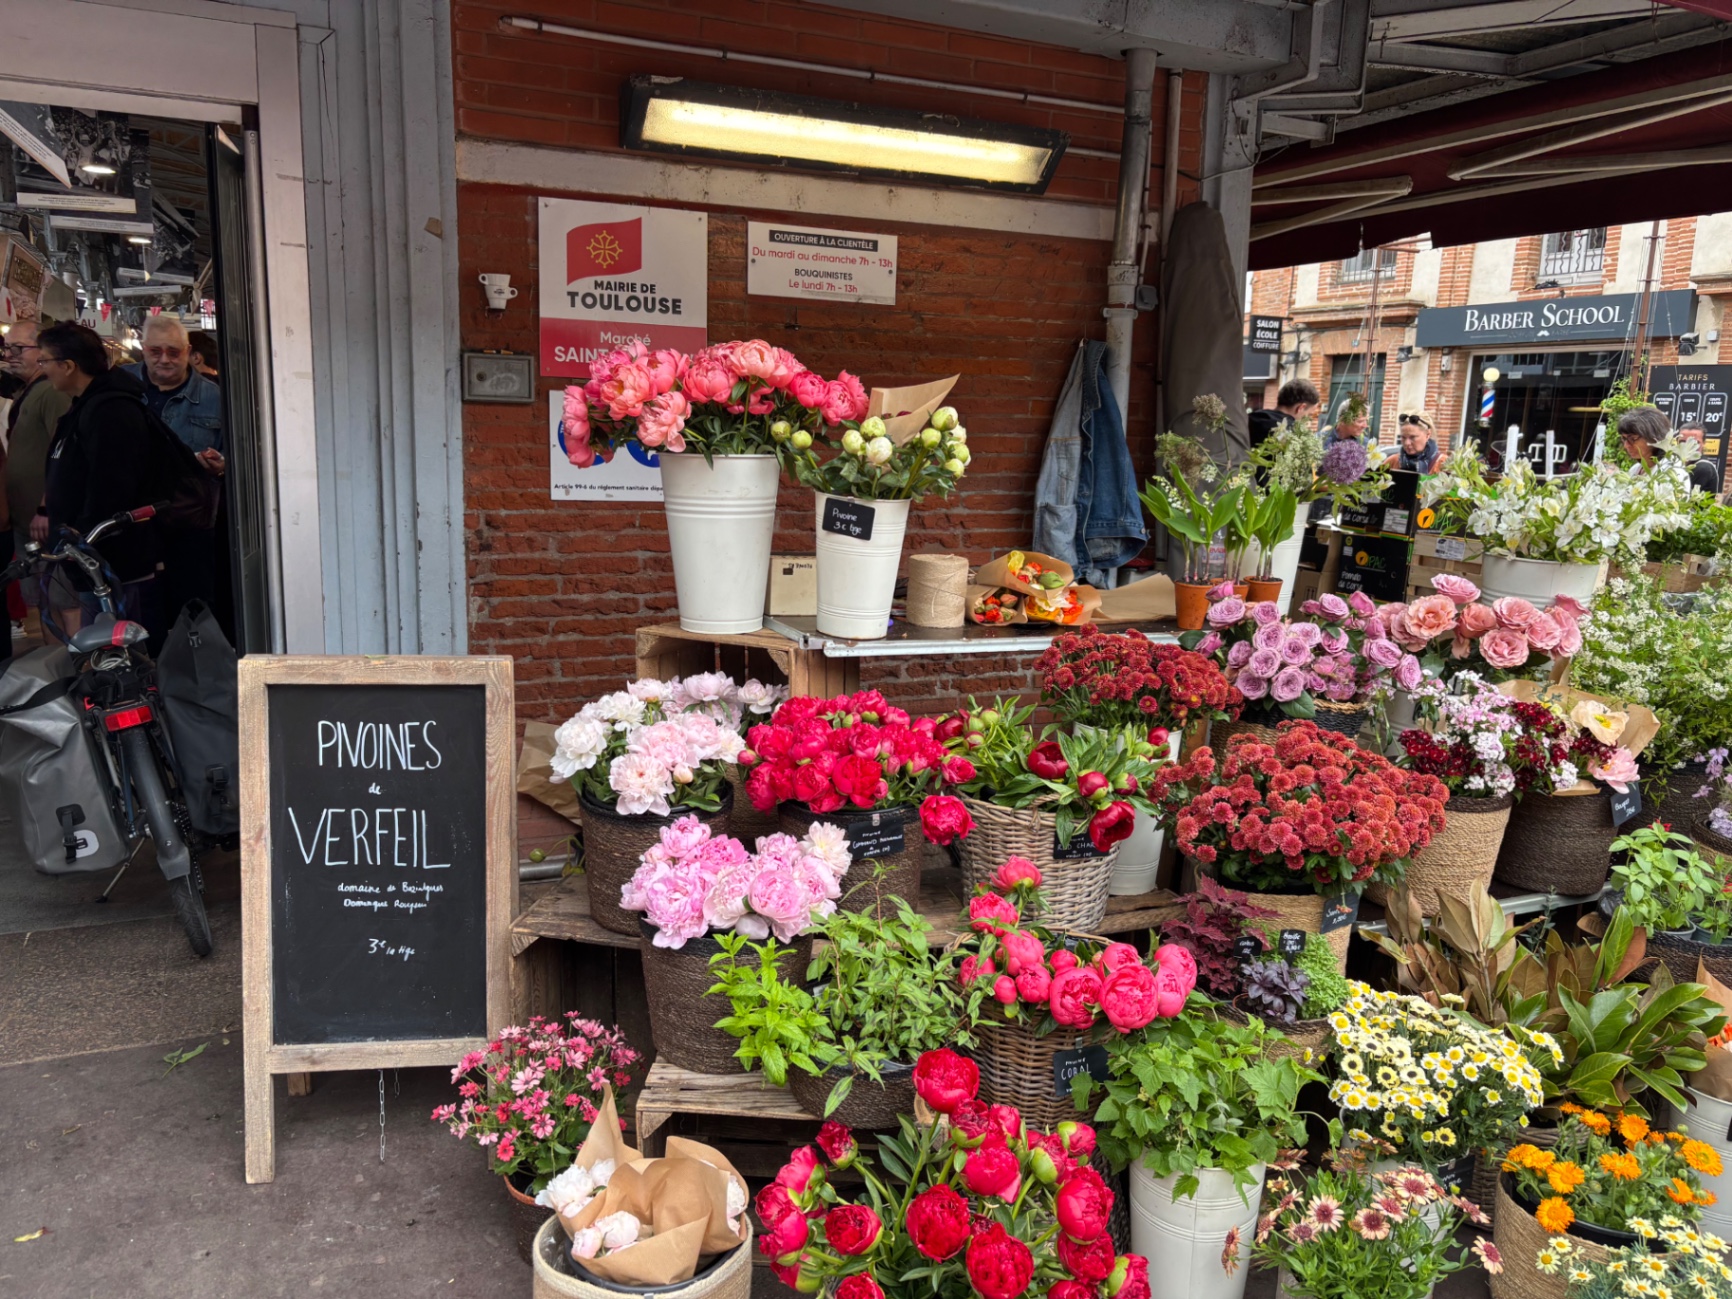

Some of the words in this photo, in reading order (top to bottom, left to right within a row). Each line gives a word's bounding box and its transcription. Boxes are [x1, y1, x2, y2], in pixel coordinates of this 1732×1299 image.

[774, 233, 818, 244] OUVERTURE
[819, 236, 825, 245] À
[837, 239, 874, 249] CLIENTÈLE
[752, 247, 766, 256] Du
[768, 248, 795, 259] mardi
[798, 252, 810, 260] au
[812, 252, 857, 265] dimanche
[858, 256, 869, 266] 7h
[879, 258, 893, 268] 13h
[794, 268, 853, 281] BOUQUINISTES
[594, 280, 637, 293] MAIRIE
[640, 283, 657, 294] DE
[788, 279, 799, 288] Le
[802, 280, 824, 290] lundi
[826, 282, 836, 291] 7h
[844, 284, 858, 293] 13h
[567, 291, 682, 315] TOULOUSE
[1464, 309, 1535, 332] BARBER
[1540, 302, 1625, 328] SCHOOL
[1256, 320, 1279, 329] SALON
[600, 331, 651, 346] Marché
[1256, 329, 1278, 339] ÉCOLE
[1252, 342, 1279, 350] COIFFURE
[1668, 383, 1716, 391] BARBIER
[1681, 412, 1697, 422] 15€
[1705, 412, 1723, 423] 20€
[318, 720, 442, 770] PIVOINES
[368, 782, 382, 795] de
[288, 807, 451, 869] VERFEIL
[337, 880, 381, 894] domaine
[386, 947, 395, 955] la
[398, 946, 415, 962] tige
